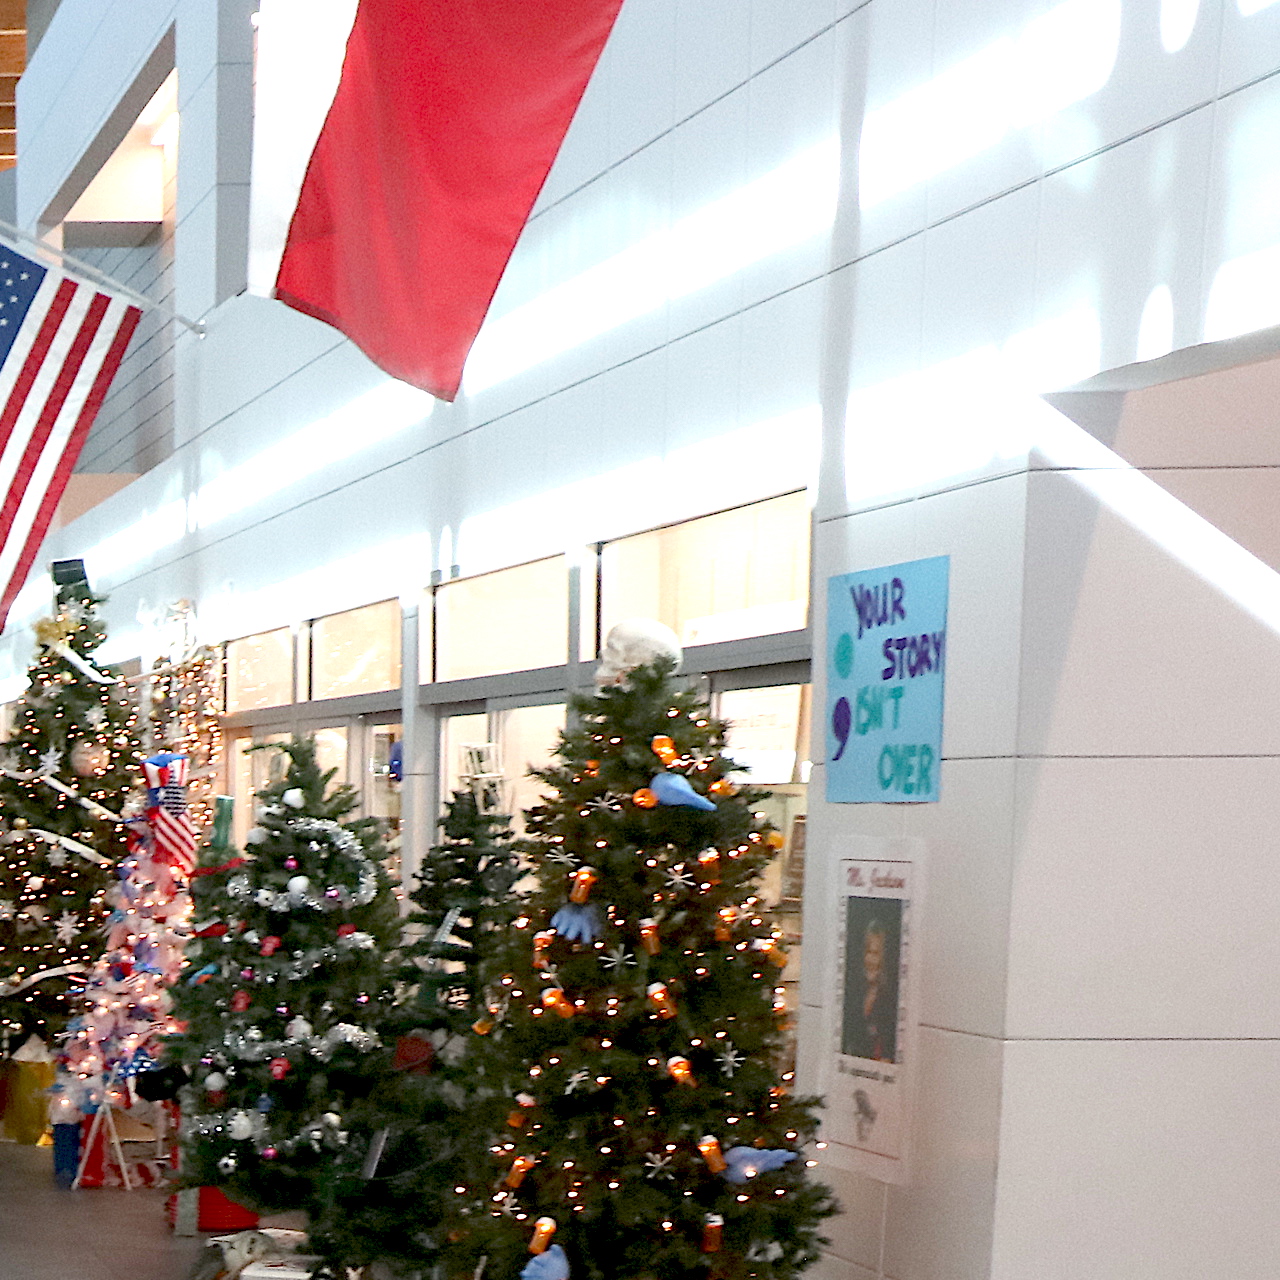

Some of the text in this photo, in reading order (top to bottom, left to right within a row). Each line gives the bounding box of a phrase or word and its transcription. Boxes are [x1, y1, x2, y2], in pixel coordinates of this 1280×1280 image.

[849, 577, 906, 640] YOUR
[881, 630, 945, 680] STORY
[877, 743, 934, 795] OVER
